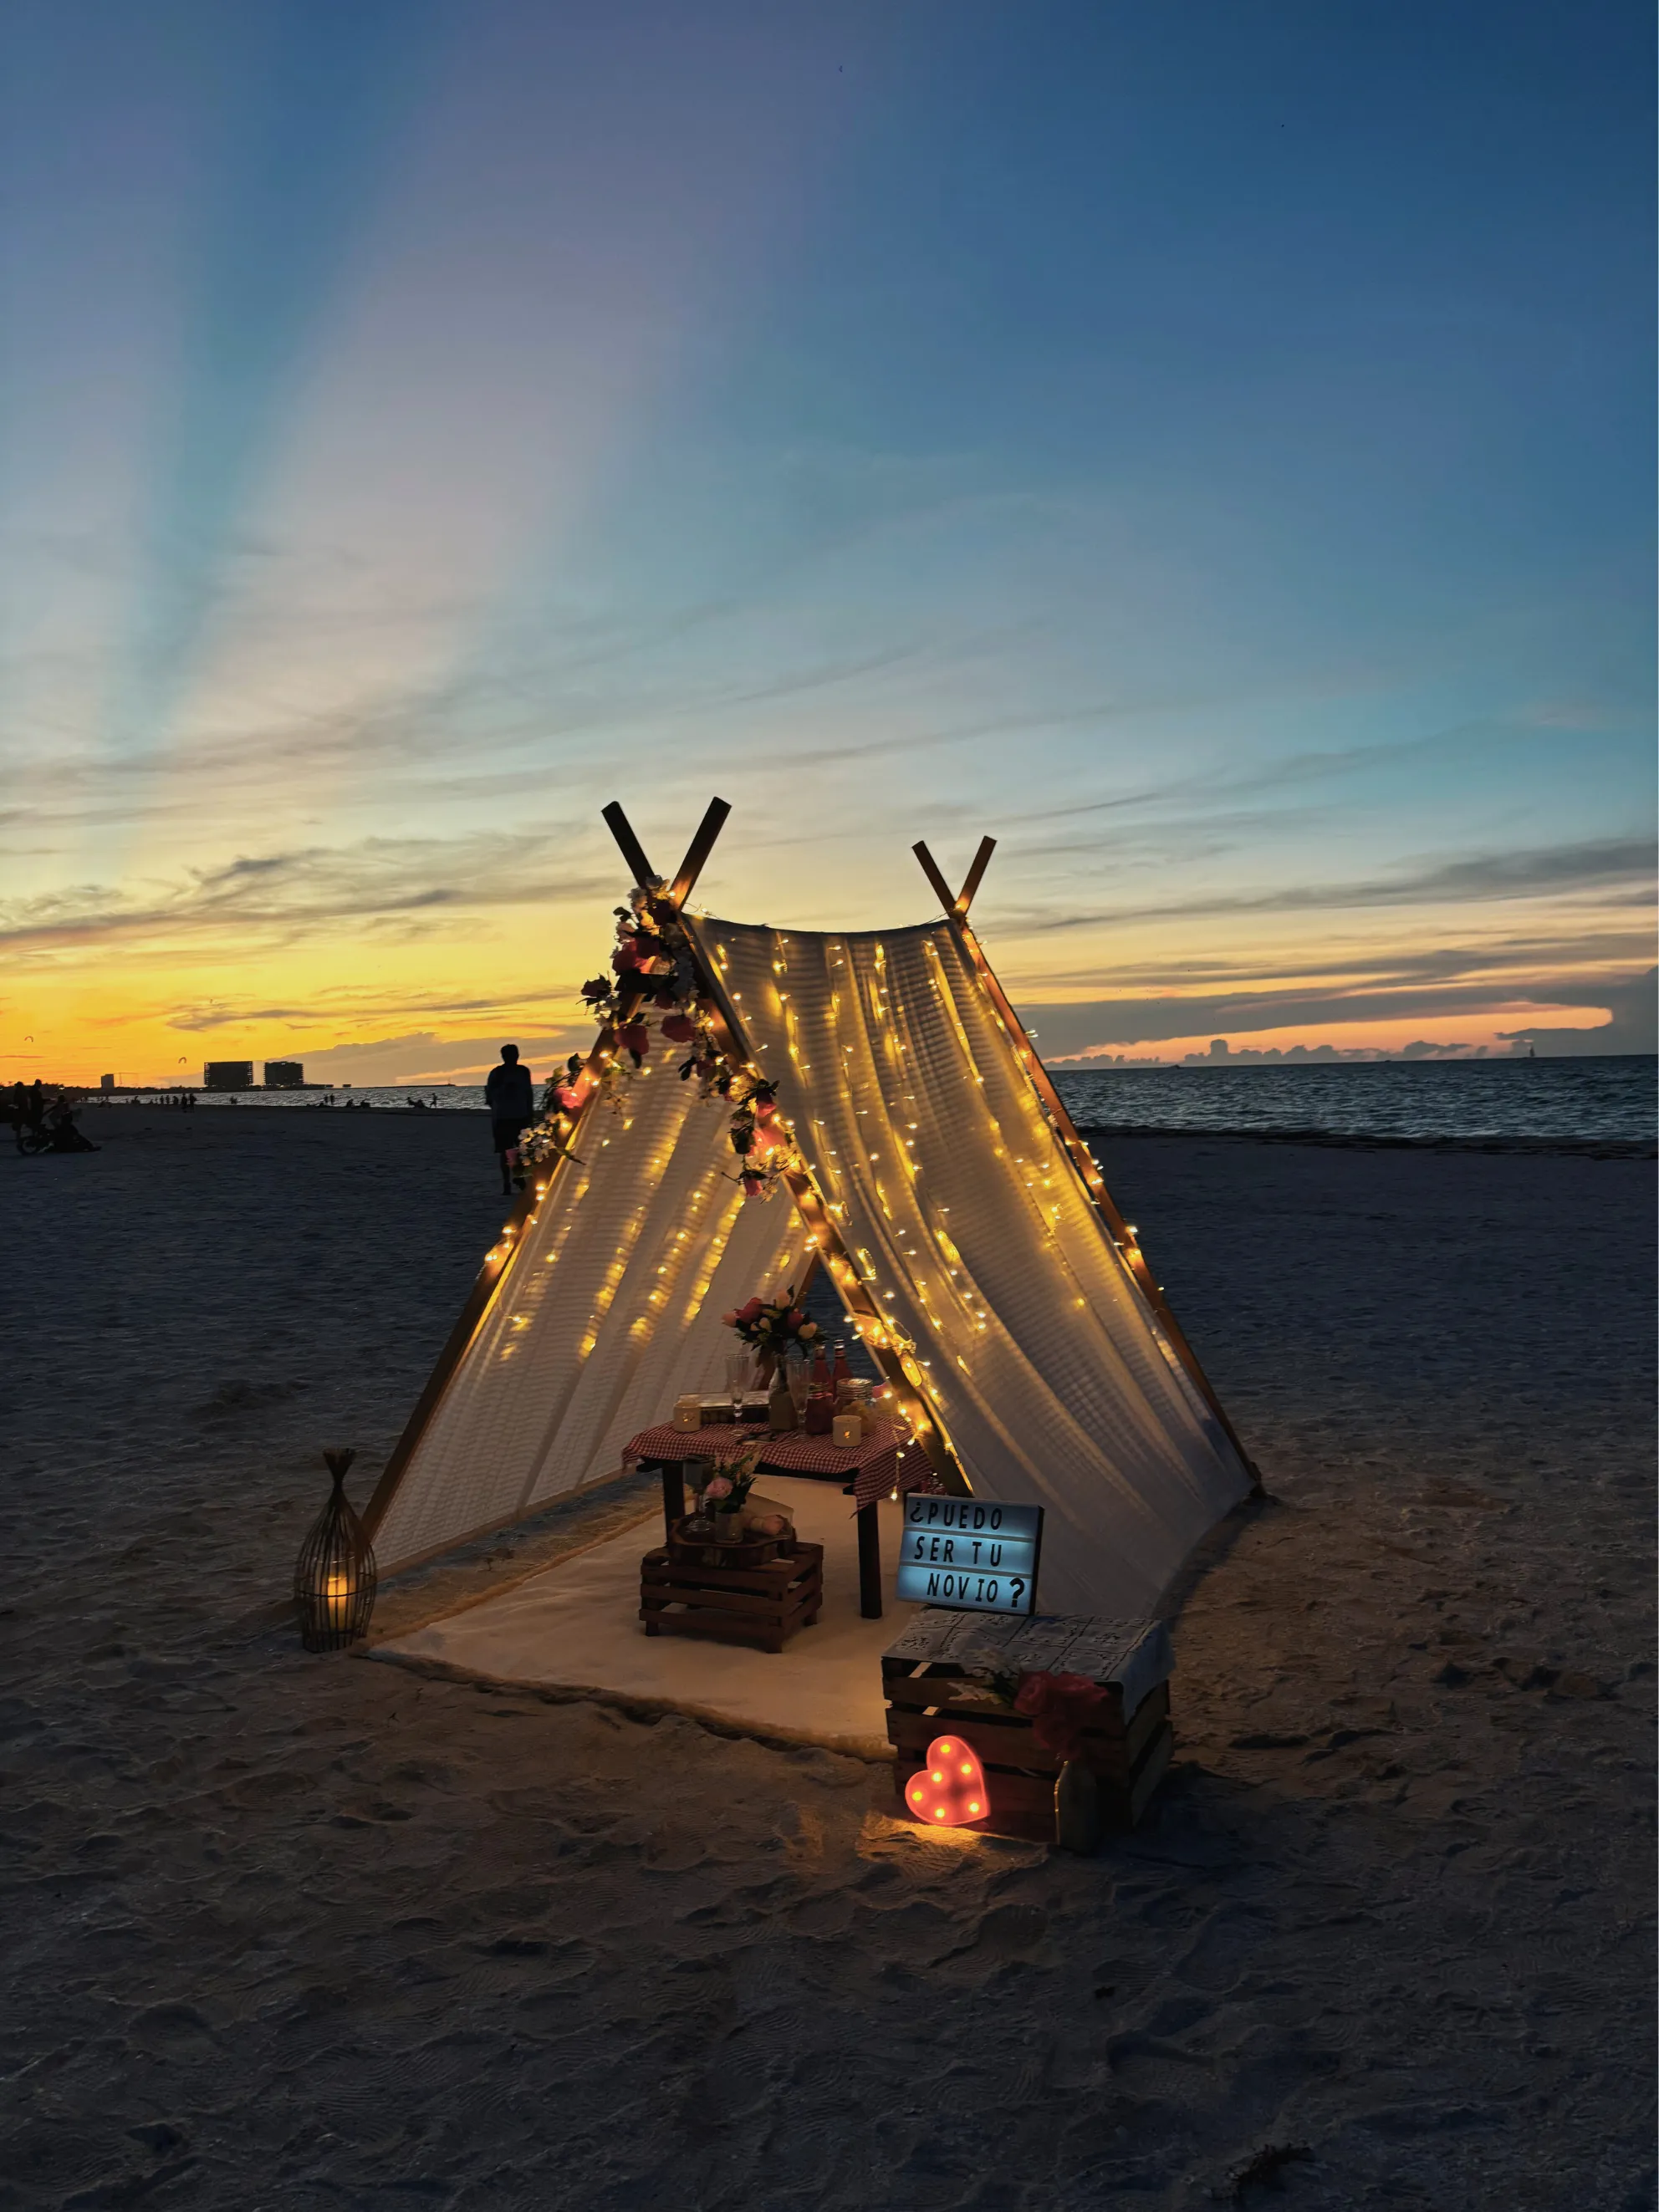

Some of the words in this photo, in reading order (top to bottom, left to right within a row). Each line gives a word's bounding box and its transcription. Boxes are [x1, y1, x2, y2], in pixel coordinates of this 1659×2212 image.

[909, 1501, 1003, 1530] ¿PUEDO
[913, 1536, 954, 1563] SER
[972, 1541, 1002, 1567] TU
[926, 1572, 1024, 1608] NOVIO?
